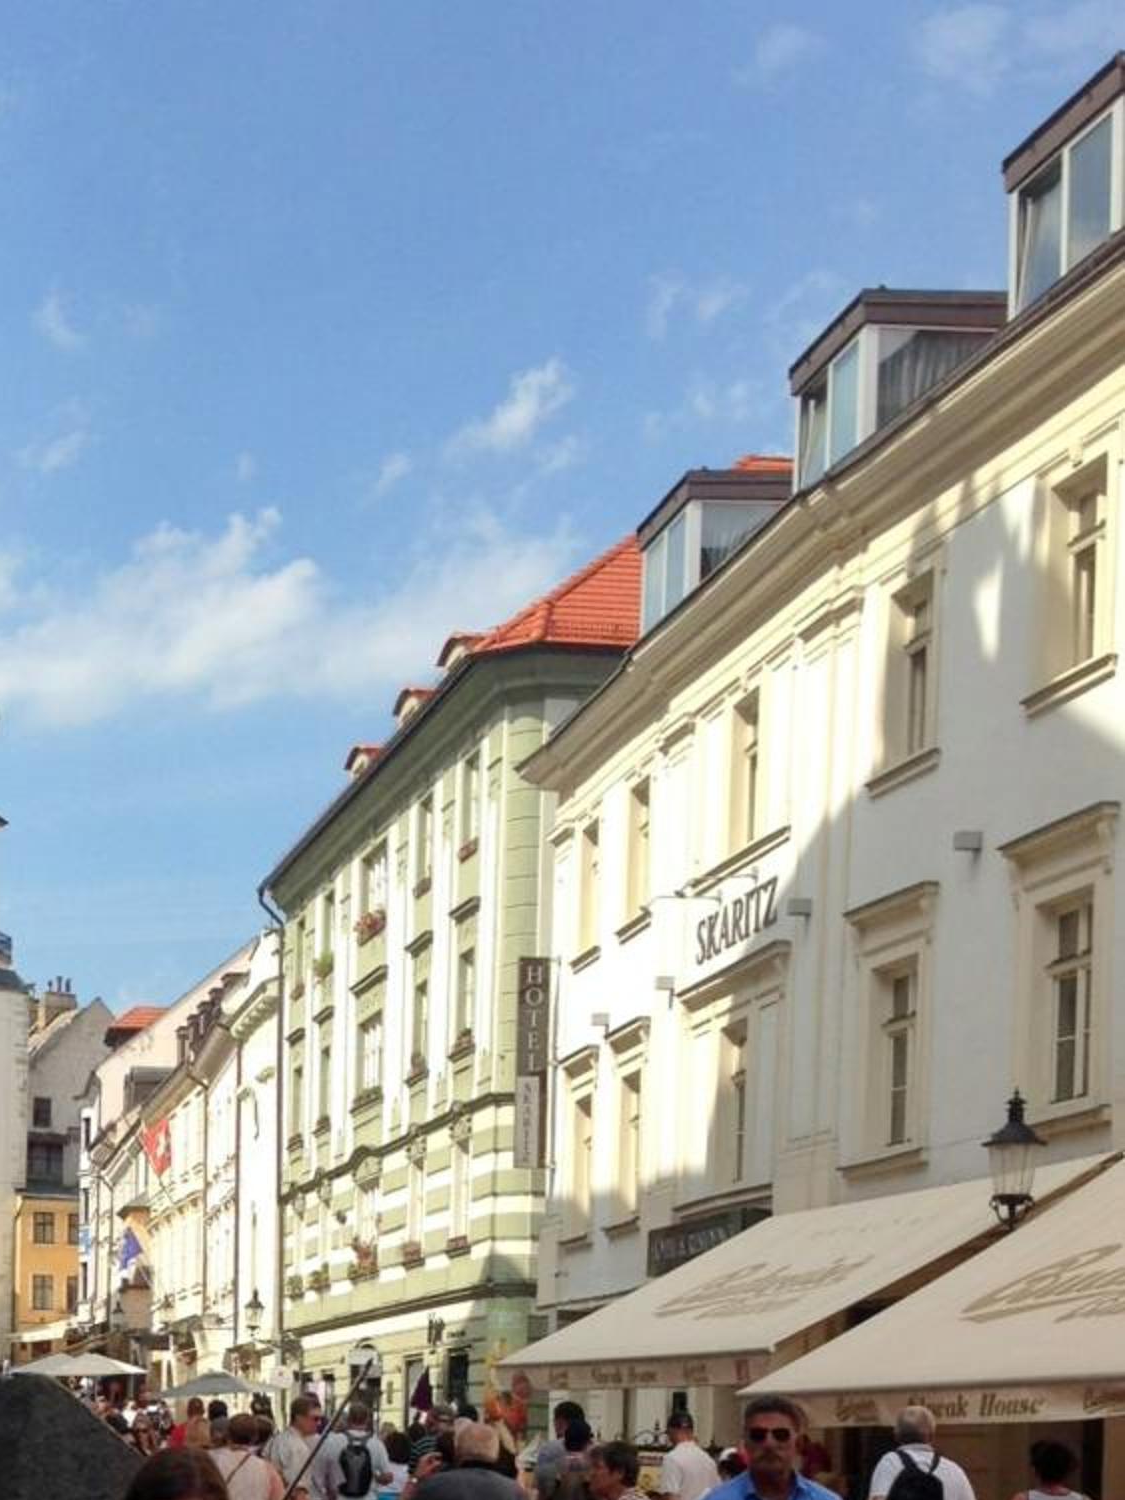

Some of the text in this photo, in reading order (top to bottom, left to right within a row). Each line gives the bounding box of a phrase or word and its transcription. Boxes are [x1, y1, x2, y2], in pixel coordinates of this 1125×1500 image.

[696, 874, 778, 966] SKARITZ
[526, 964, 544, 1073] HOTEL
[979, 1390, 1042, 1416] House
